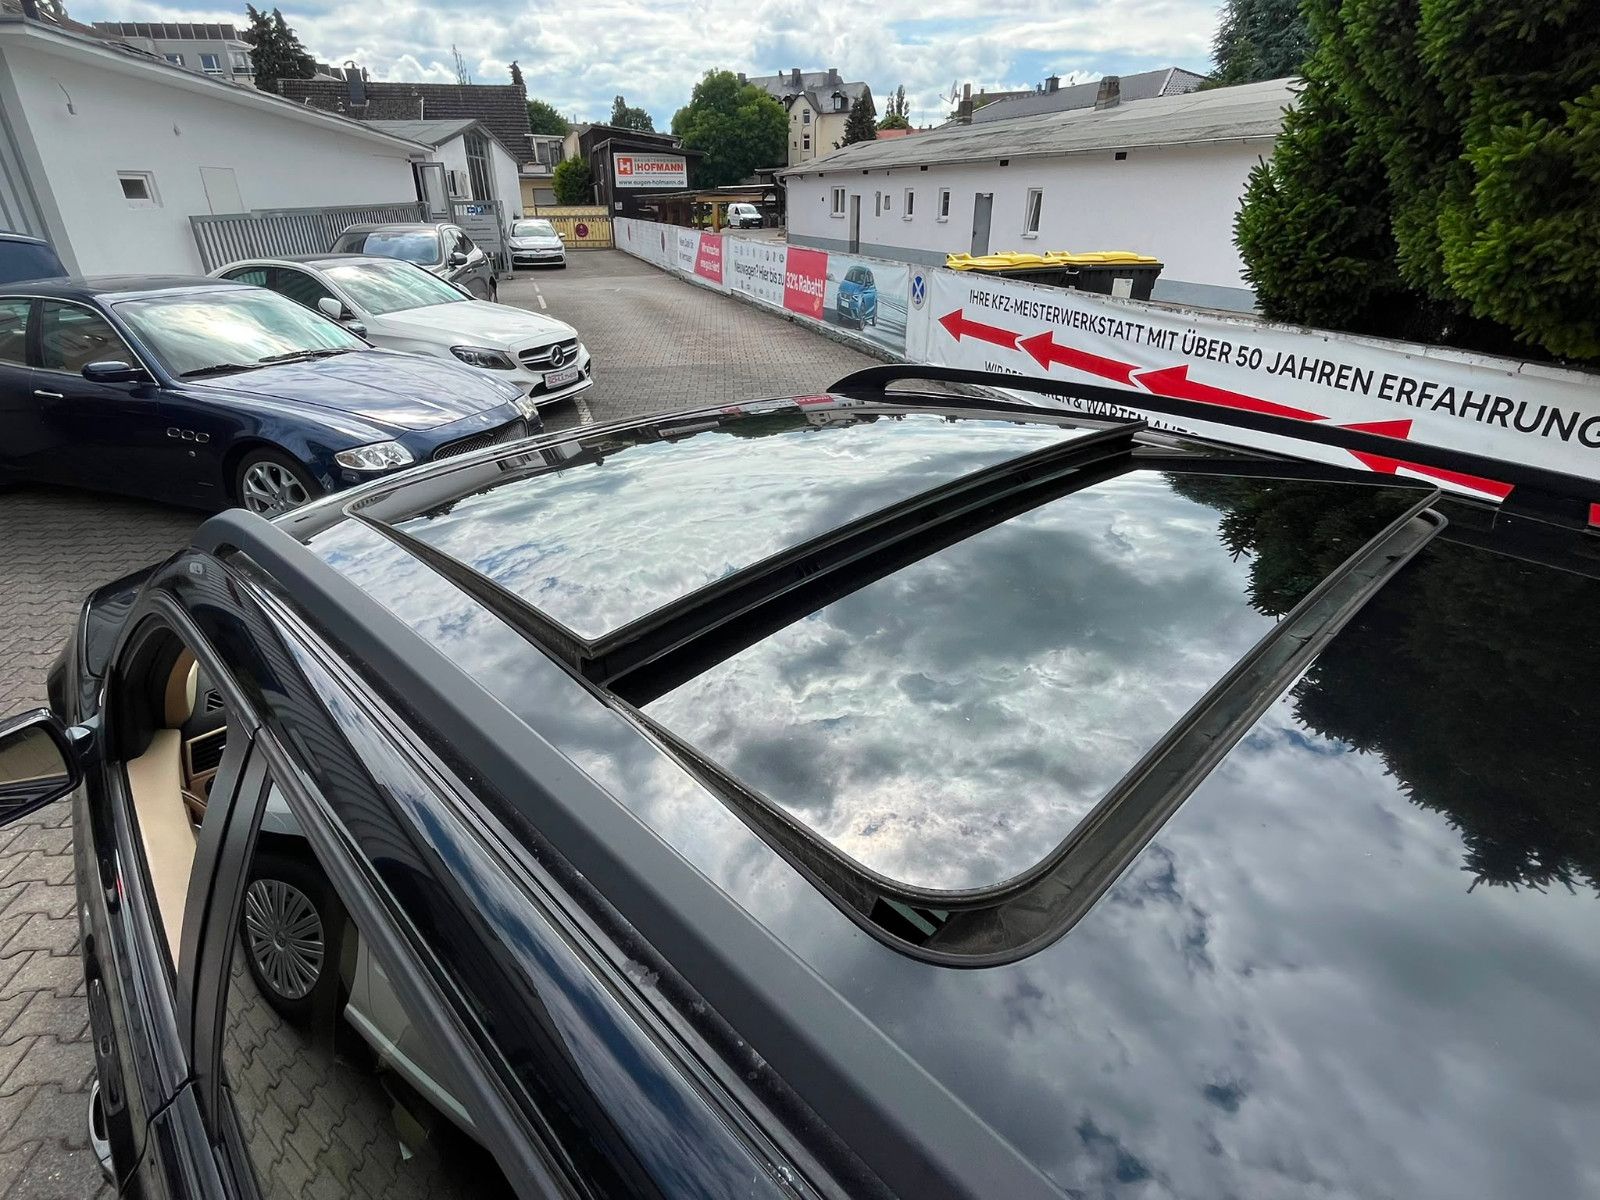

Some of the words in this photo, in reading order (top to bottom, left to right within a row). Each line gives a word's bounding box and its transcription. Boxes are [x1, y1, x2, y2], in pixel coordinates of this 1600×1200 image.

[637, 163, 684, 171] HOFMANN
[734, 260, 759, 280] Neuwagen?
[778, 273, 784, 286] zu
[786, 272, 798, 291] 32%
[799, 273, 824, 297] Rabatt!
[970, 289, 990, 307] IHRE
[992, 293, 1144, 343] KFZ-MEISTERWERKSTATT
[1147, 327, 1178, 350] MIT
[1182, 329, 1232, 363] ÜBER
[1236, 345, 1262, 370] 50
[1266, 352, 1374, 395] JAHREN
[1378, 374, 1600, 448] ERFAHRUNG
